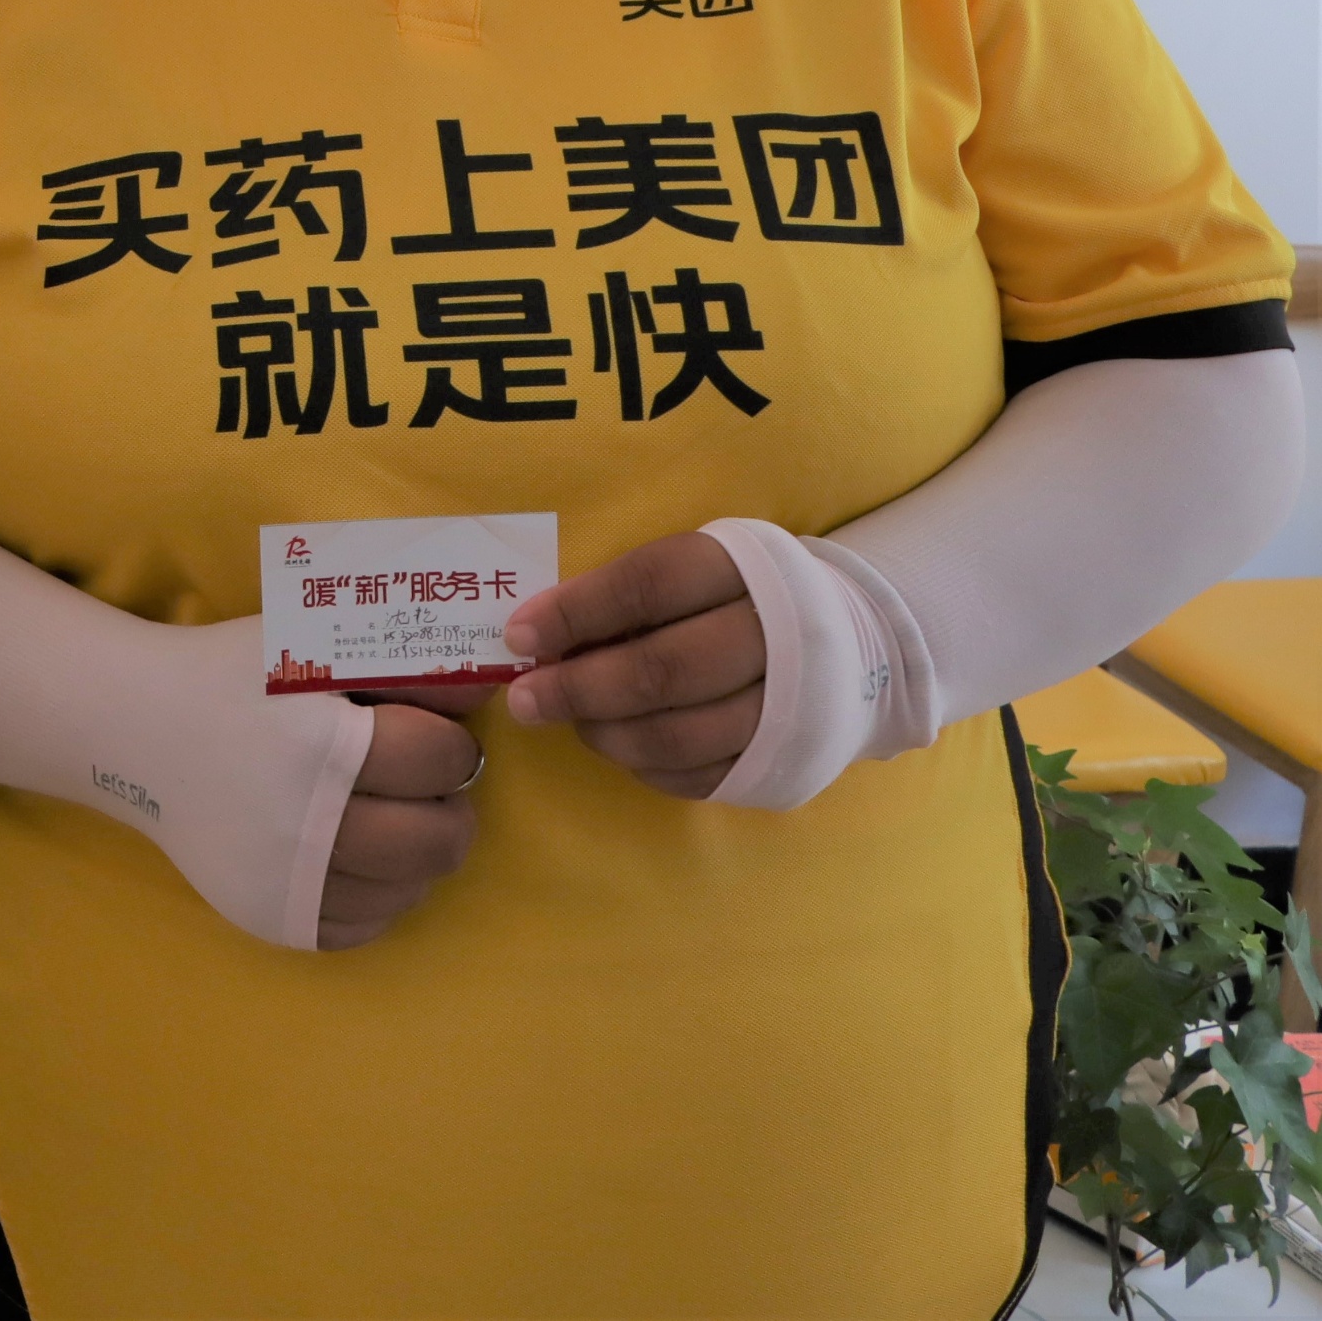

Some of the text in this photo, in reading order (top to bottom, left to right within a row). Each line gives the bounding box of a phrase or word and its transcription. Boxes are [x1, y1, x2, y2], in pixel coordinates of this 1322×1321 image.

[37, 111, 905, 288] 买药上美团
[211, 267, 772, 440] 就是快
[302, 569, 517, 608] 暖“新”服务卡
